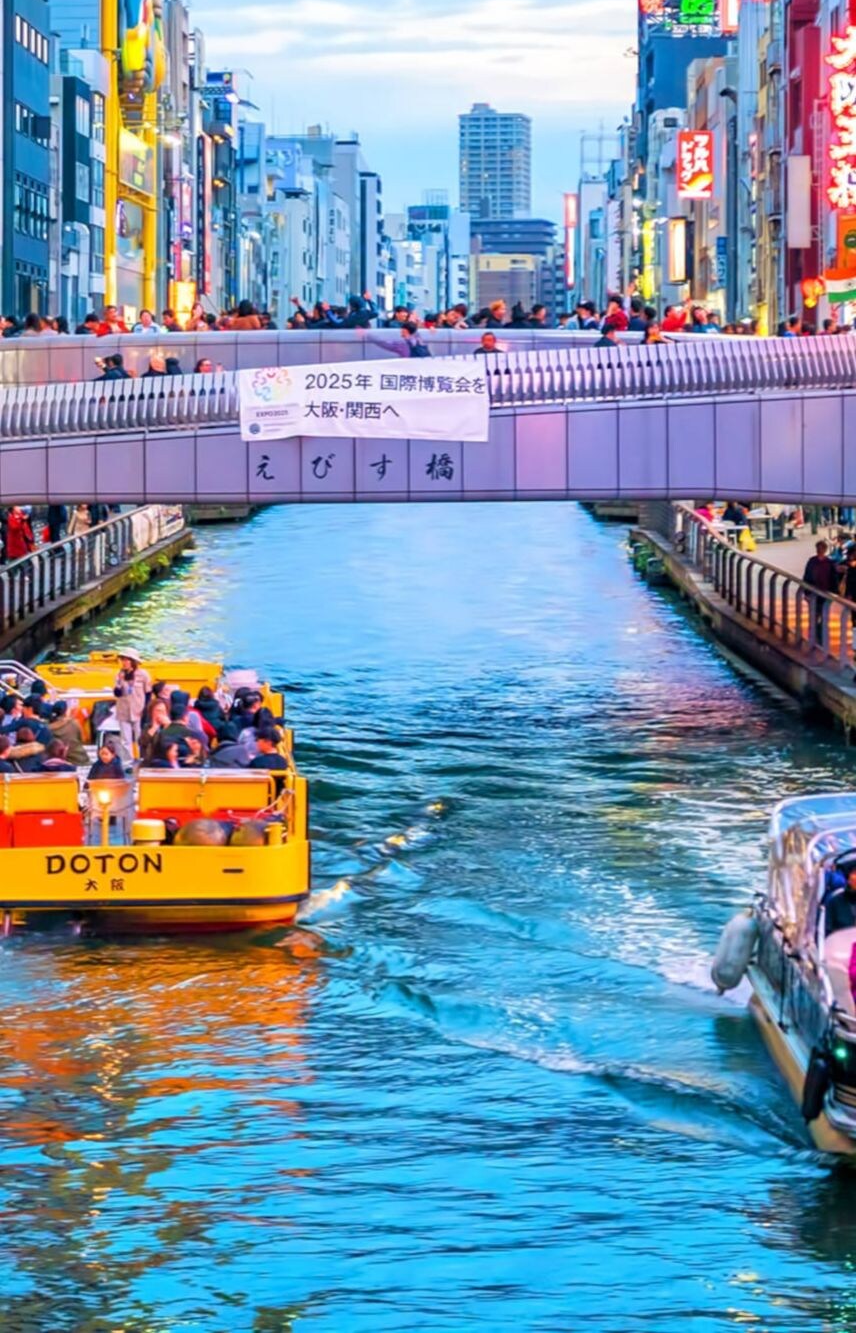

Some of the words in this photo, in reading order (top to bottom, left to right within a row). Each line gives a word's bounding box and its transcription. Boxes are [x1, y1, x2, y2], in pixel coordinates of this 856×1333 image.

[305, 374, 373, 391] 2025年
[380, 374, 487, 395] 国際博覧会を
[304, 400, 400, 420] 大阪・関西へ
[256, 453, 454, 481] えびす橋
[46, 852, 163, 875] DOTON
[85, 878, 125, 892] 大阪
